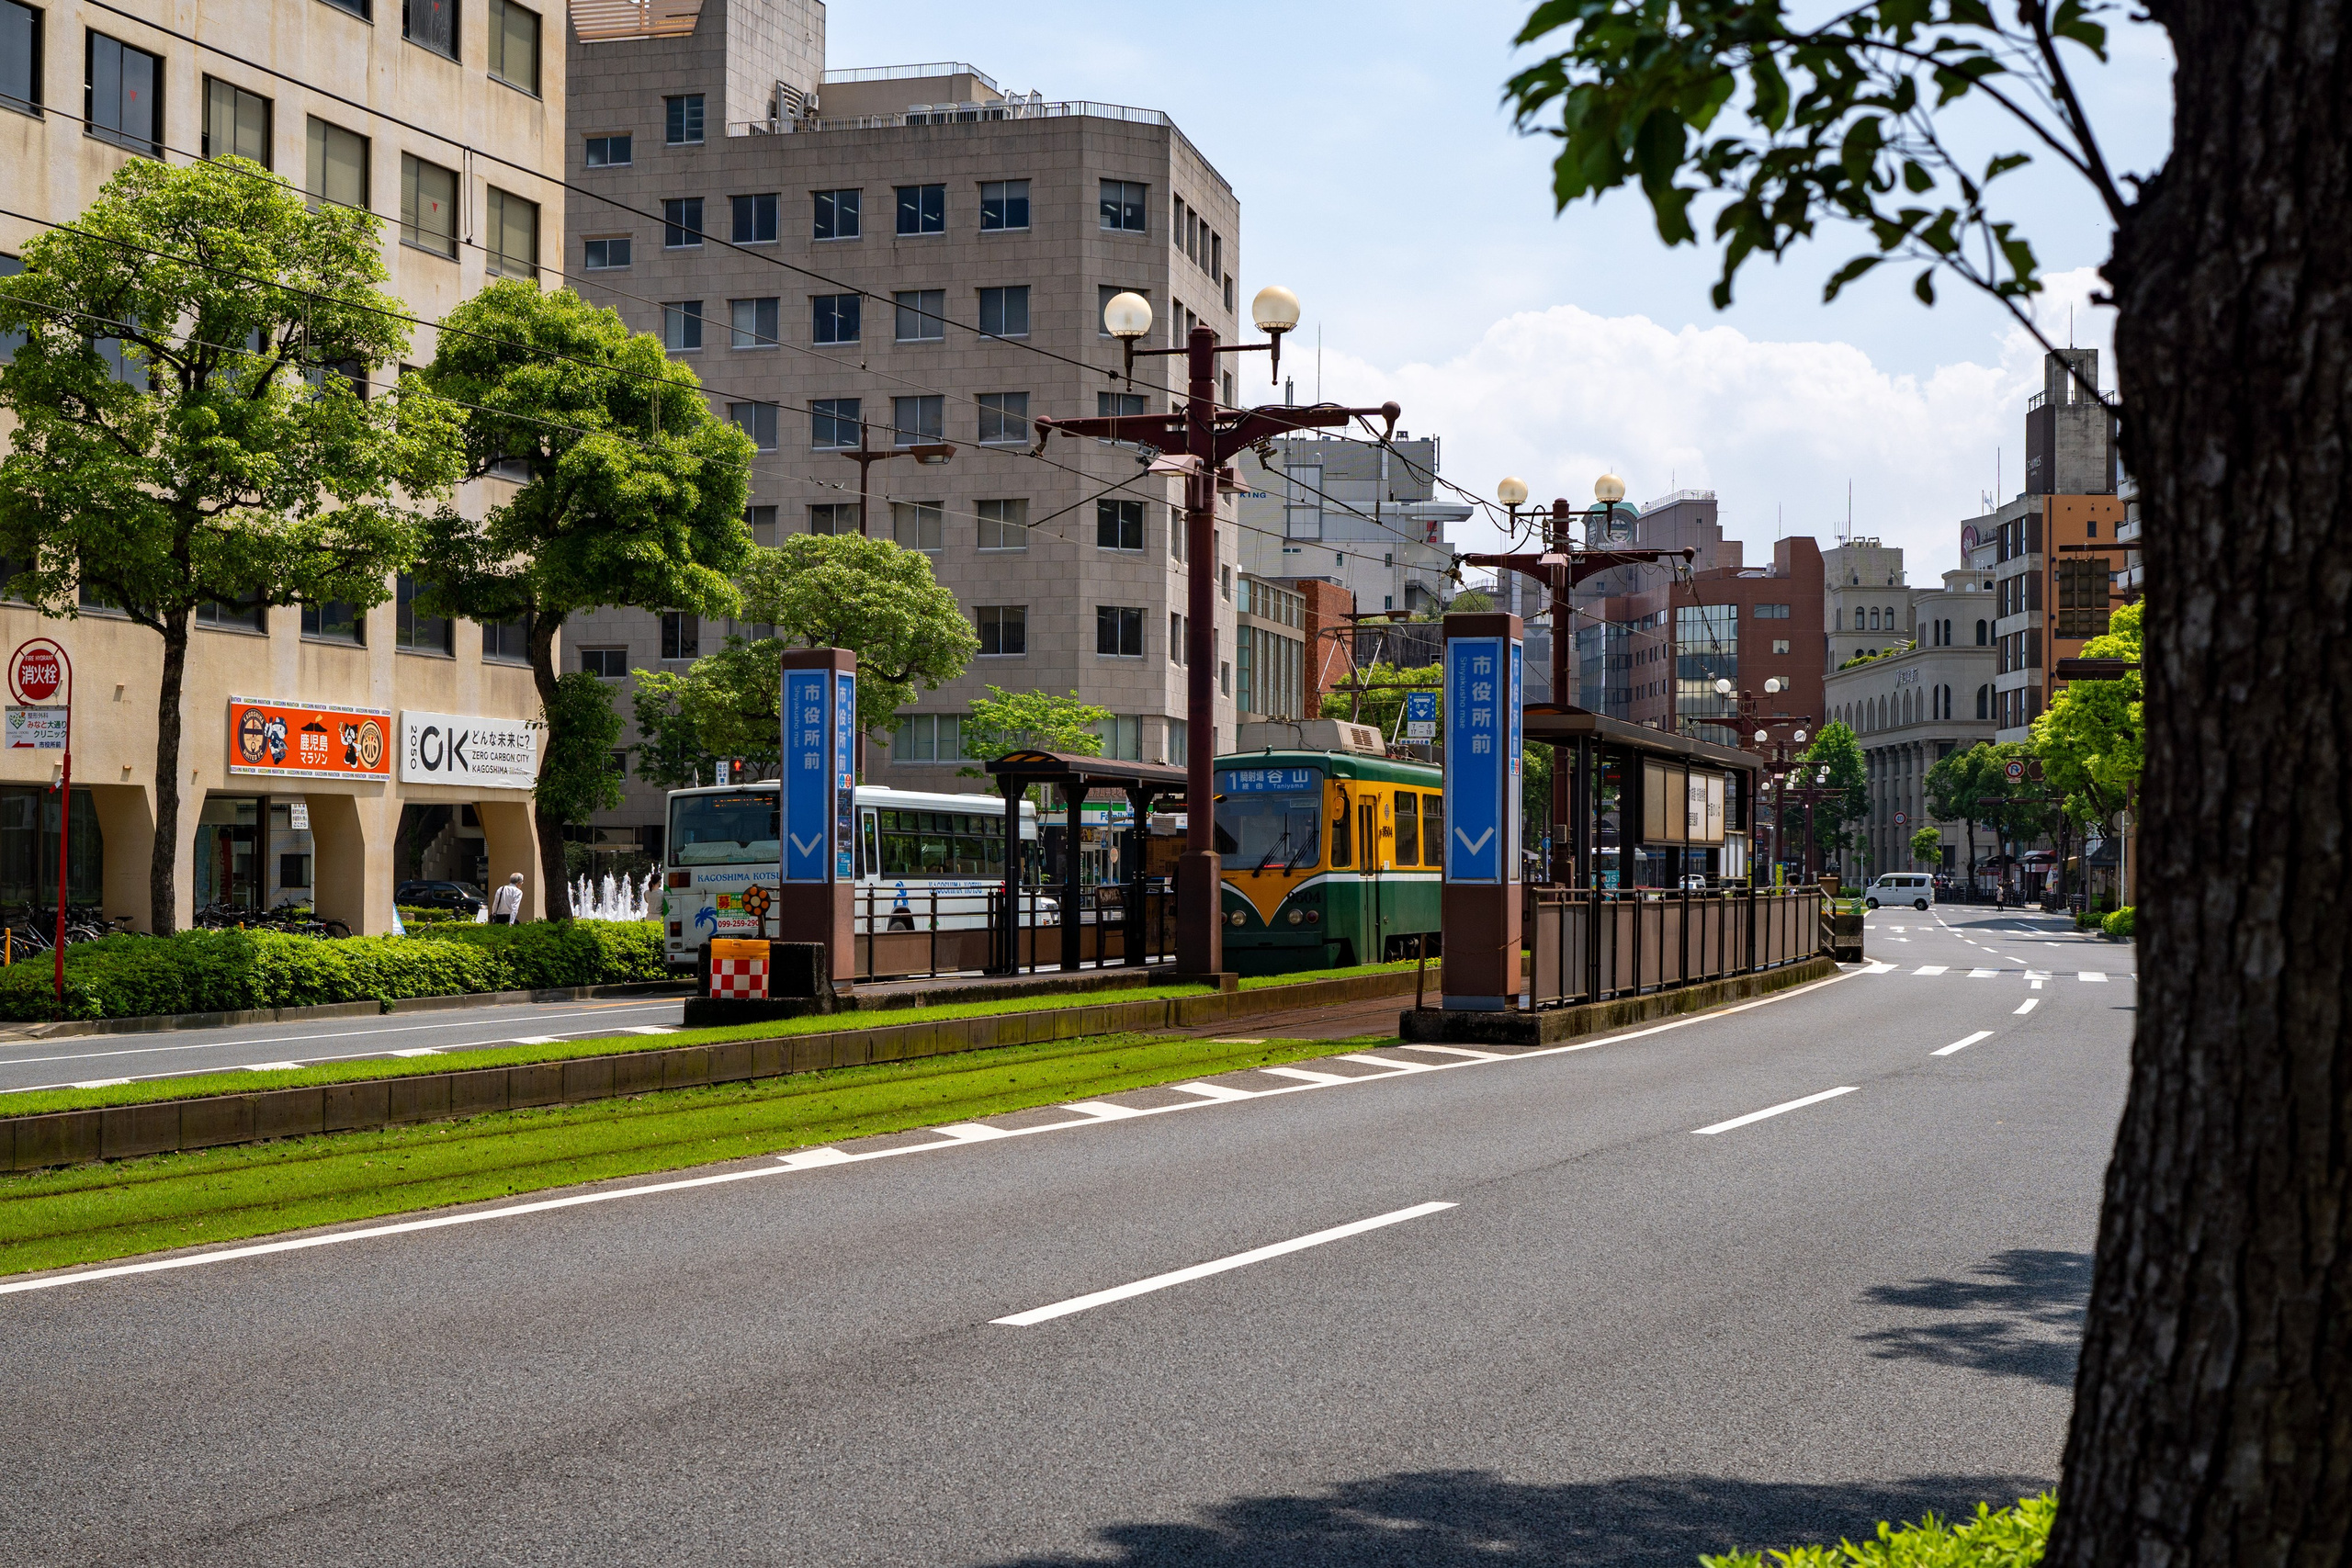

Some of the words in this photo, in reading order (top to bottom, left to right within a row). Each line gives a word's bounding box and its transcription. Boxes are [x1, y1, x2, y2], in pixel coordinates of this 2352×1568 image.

[22, 663, 57, 684] 消火栓
[1458, 656, 1467, 708] Shiyakusho
[793, 685, 801, 729] Shiyakusho
[1472, 656, 1492, 753] 市役所前
[28, 720, 67, 728] みなと大通り
[804, 683, 820, 770] 市役所前
[838, 687, 846, 772] 市役所前
[33, 730, 67, 739] クリニック
[300, 733, 328, 751] 鹿児島
[300, 752, 327, 764] マラソン
[420, 726, 469, 772] OK
[472, 751, 489, 761] ZERO
[491, 751, 514, 762] CARBON
[516, 753, 529, 762] CITY
[472, 764, 507, 775] KAGOSHIMA
[1267, 770, 1308, 783] 谷山
[1229, 772, 1237, 790] 1
[698, 873, 750, 882] KAGOSHIMA
[718, 919, 760, 928] 099-259-290
